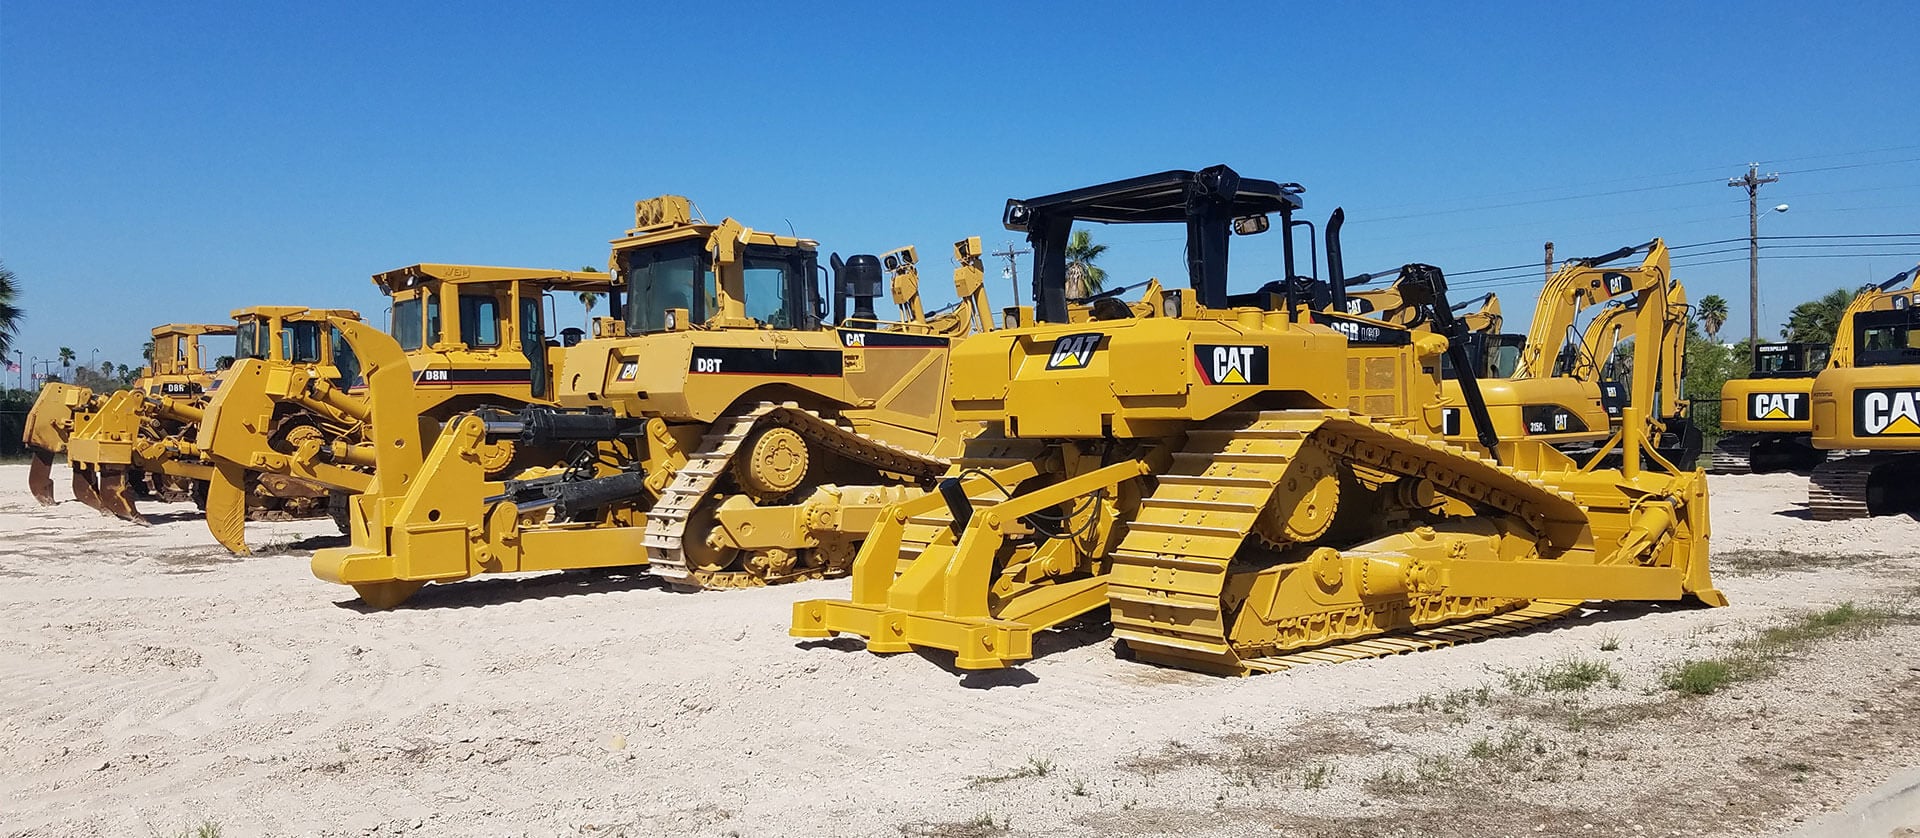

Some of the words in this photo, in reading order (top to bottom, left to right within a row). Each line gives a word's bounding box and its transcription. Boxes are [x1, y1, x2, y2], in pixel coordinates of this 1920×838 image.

[1610, 276, 1622, 294] CAT
[1346, 299, 1361, 315] CAT
[846, 333, 865, 347] CAT
[1361, 327, 1380, 341] LGP
[1050, 336, 1099, 366] CAT
[697, 358, 722, 373] D8T
[1213, 347, 1254, 383] CAT
[425, 370, 448, 380] D8N
[1607, 387, 1616, 397] CAT
[1756, 394, 1799, 418] CAT
[1865, 392, 1920, 434] CA
[1555, 415, 1567, 430] CAT
